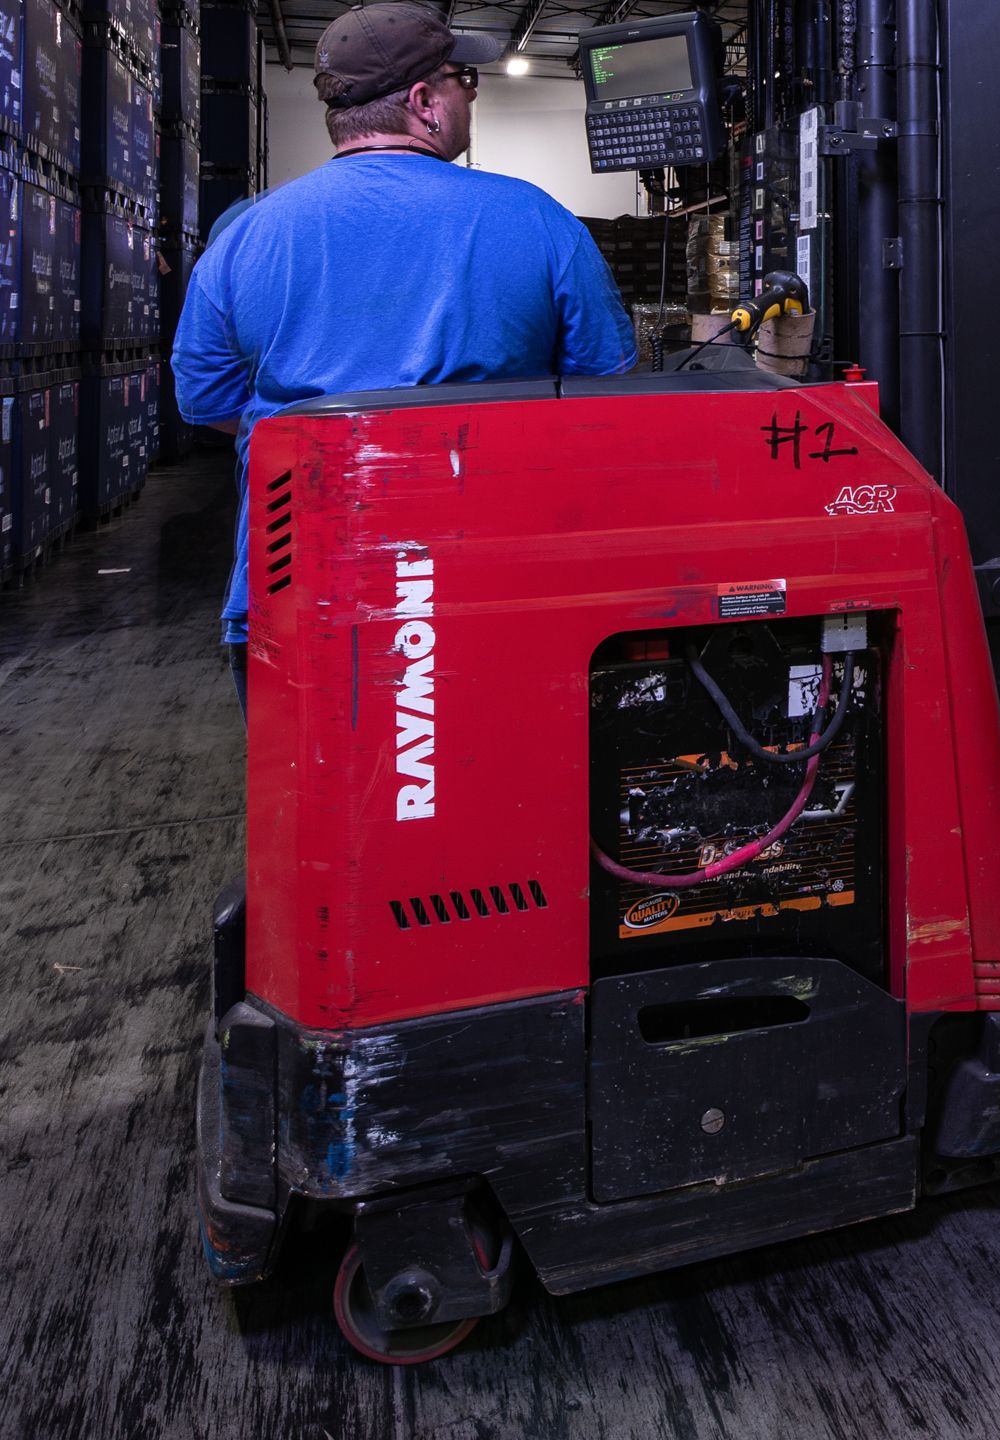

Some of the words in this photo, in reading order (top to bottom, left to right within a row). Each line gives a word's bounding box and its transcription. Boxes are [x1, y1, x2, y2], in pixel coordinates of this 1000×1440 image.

[825, 484, 897, 516] ACR
[736, 583, 774, 592] WARNING
[630, 898, 673, 922] QUALITY
[643, 909, 668, 923] MATTERS
